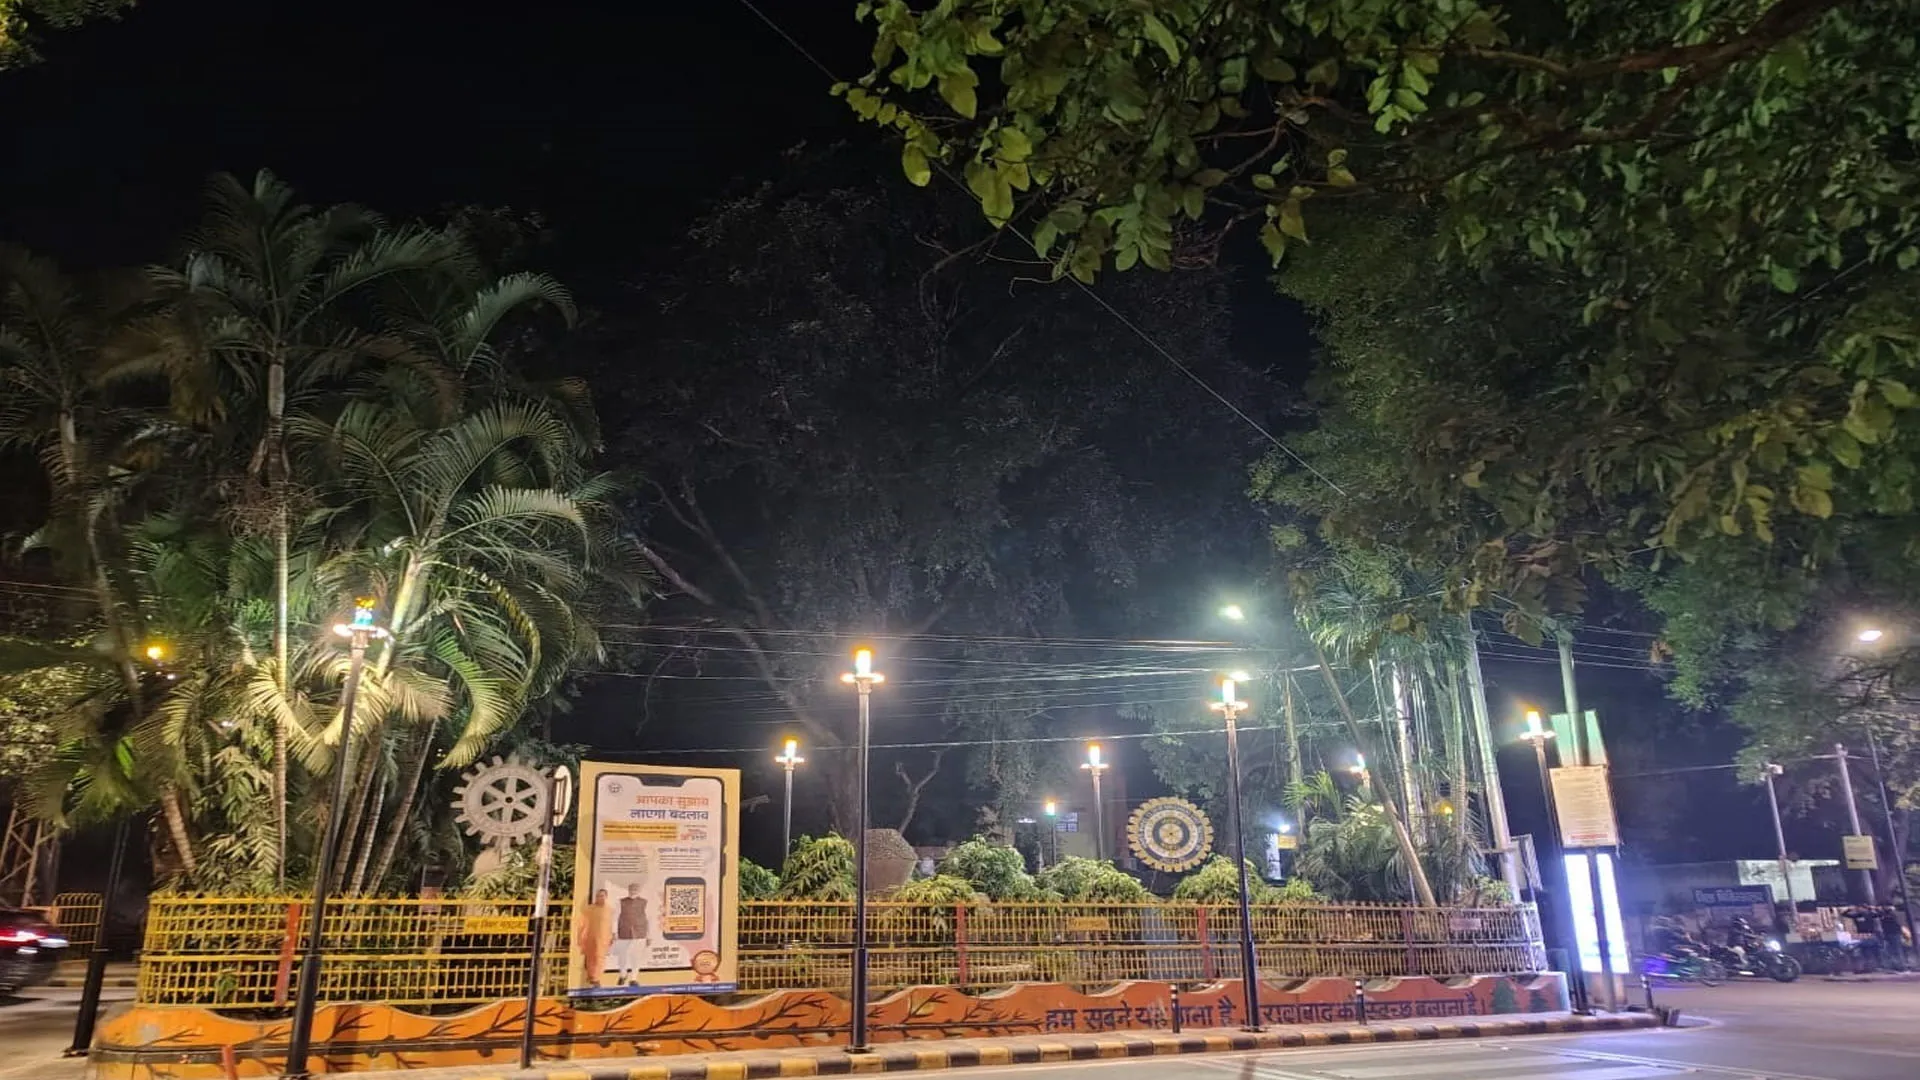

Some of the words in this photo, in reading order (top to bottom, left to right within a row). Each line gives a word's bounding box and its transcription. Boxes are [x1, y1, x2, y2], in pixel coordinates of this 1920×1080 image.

[636, 795, 673, 806] आपका
[678, 796, 709, 809] सुझाव
[630, 808, 666, 820] लाएगा
[669, 809, 709, 821] बदलाव
[1045, 1008, 1078, 1031] हम
[1082, 999, 1132, 1030] सबने
[1217, 995, 1237, 1027] है
[1259, 1002, 1334, 1024] रादाबाद
